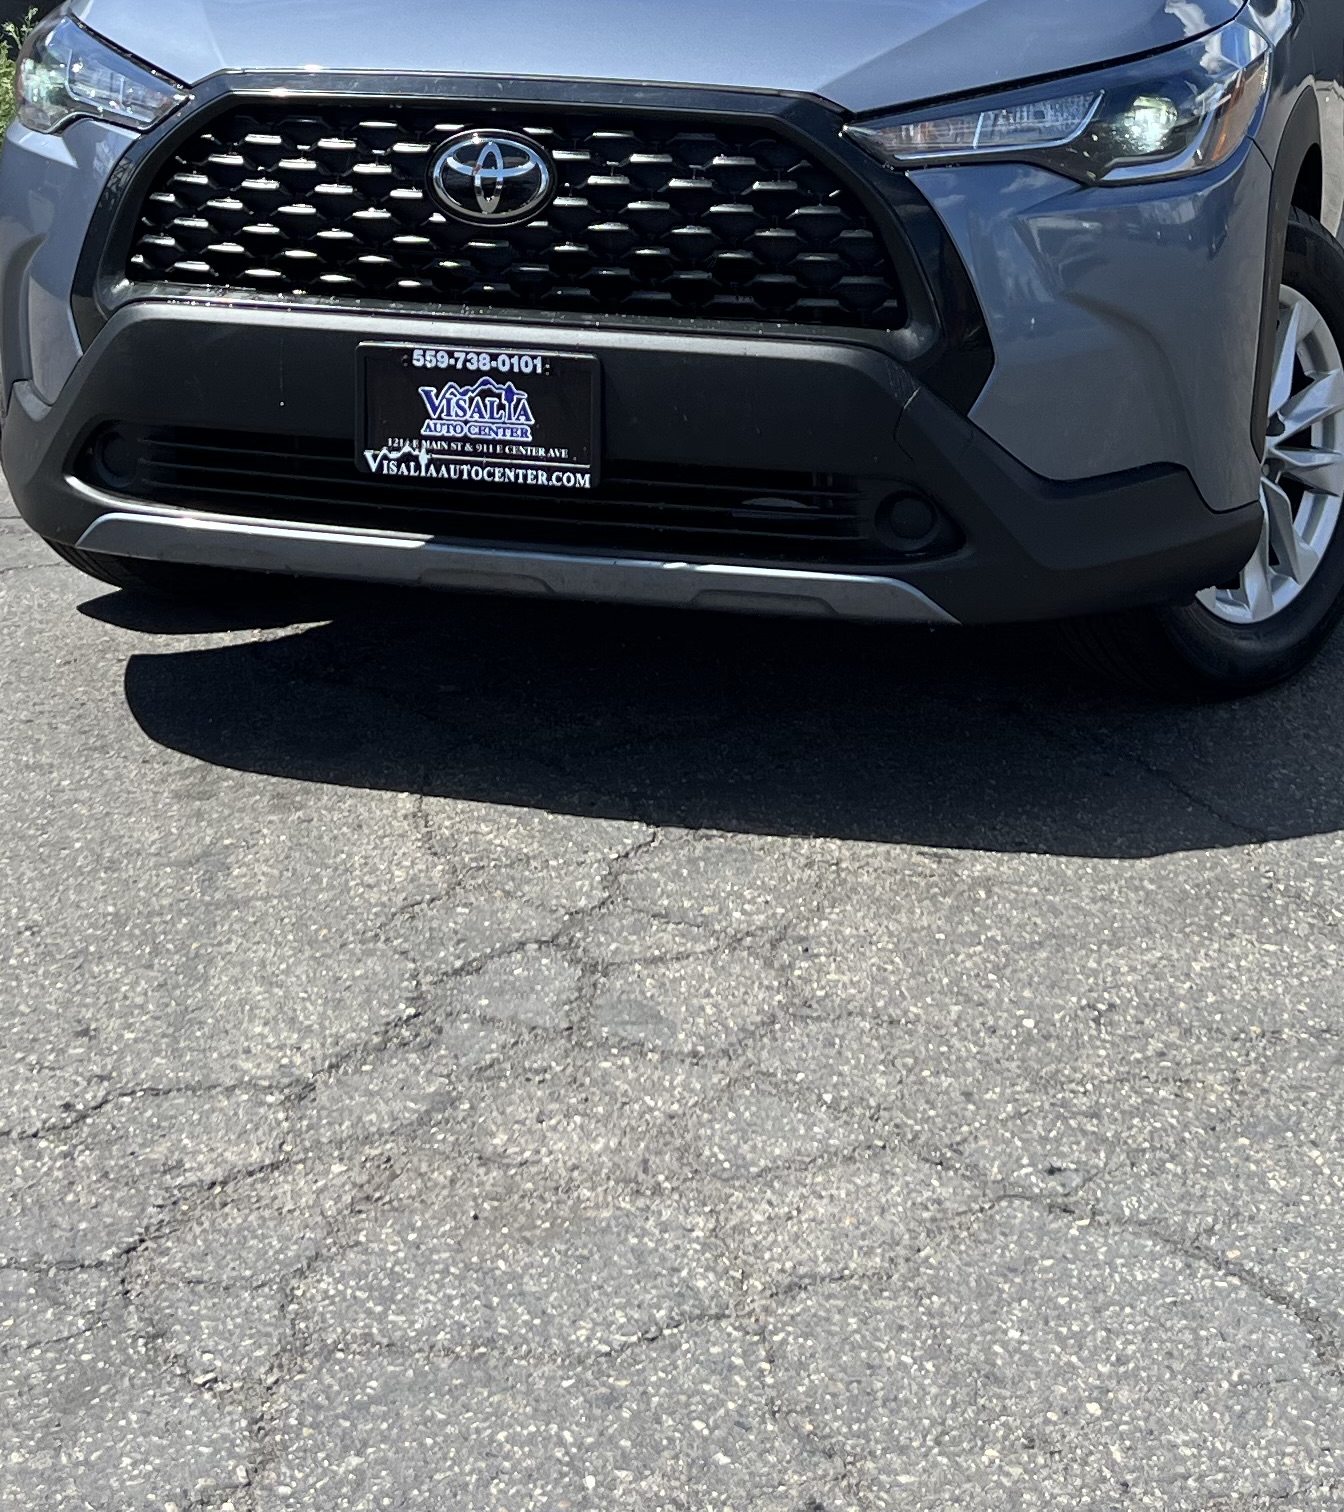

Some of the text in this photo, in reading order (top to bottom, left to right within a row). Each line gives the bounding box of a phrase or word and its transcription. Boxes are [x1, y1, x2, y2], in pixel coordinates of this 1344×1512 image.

[412, 349, 542, 374] 559-738-0101
[418, 376, 535, 424] VISALIA
[421, 419, 533, 442] AUTO CENTER
[421, 439, 448, 450] MAIN
[450, 441, 463, 451] ST
[464, 442, 473, 452] &
[476, 443, 493, 453] 911
[496, 444, 504, 453] E
[505, 445, 546, 457] CENTER
[548, 448, 568, 458] AVE
